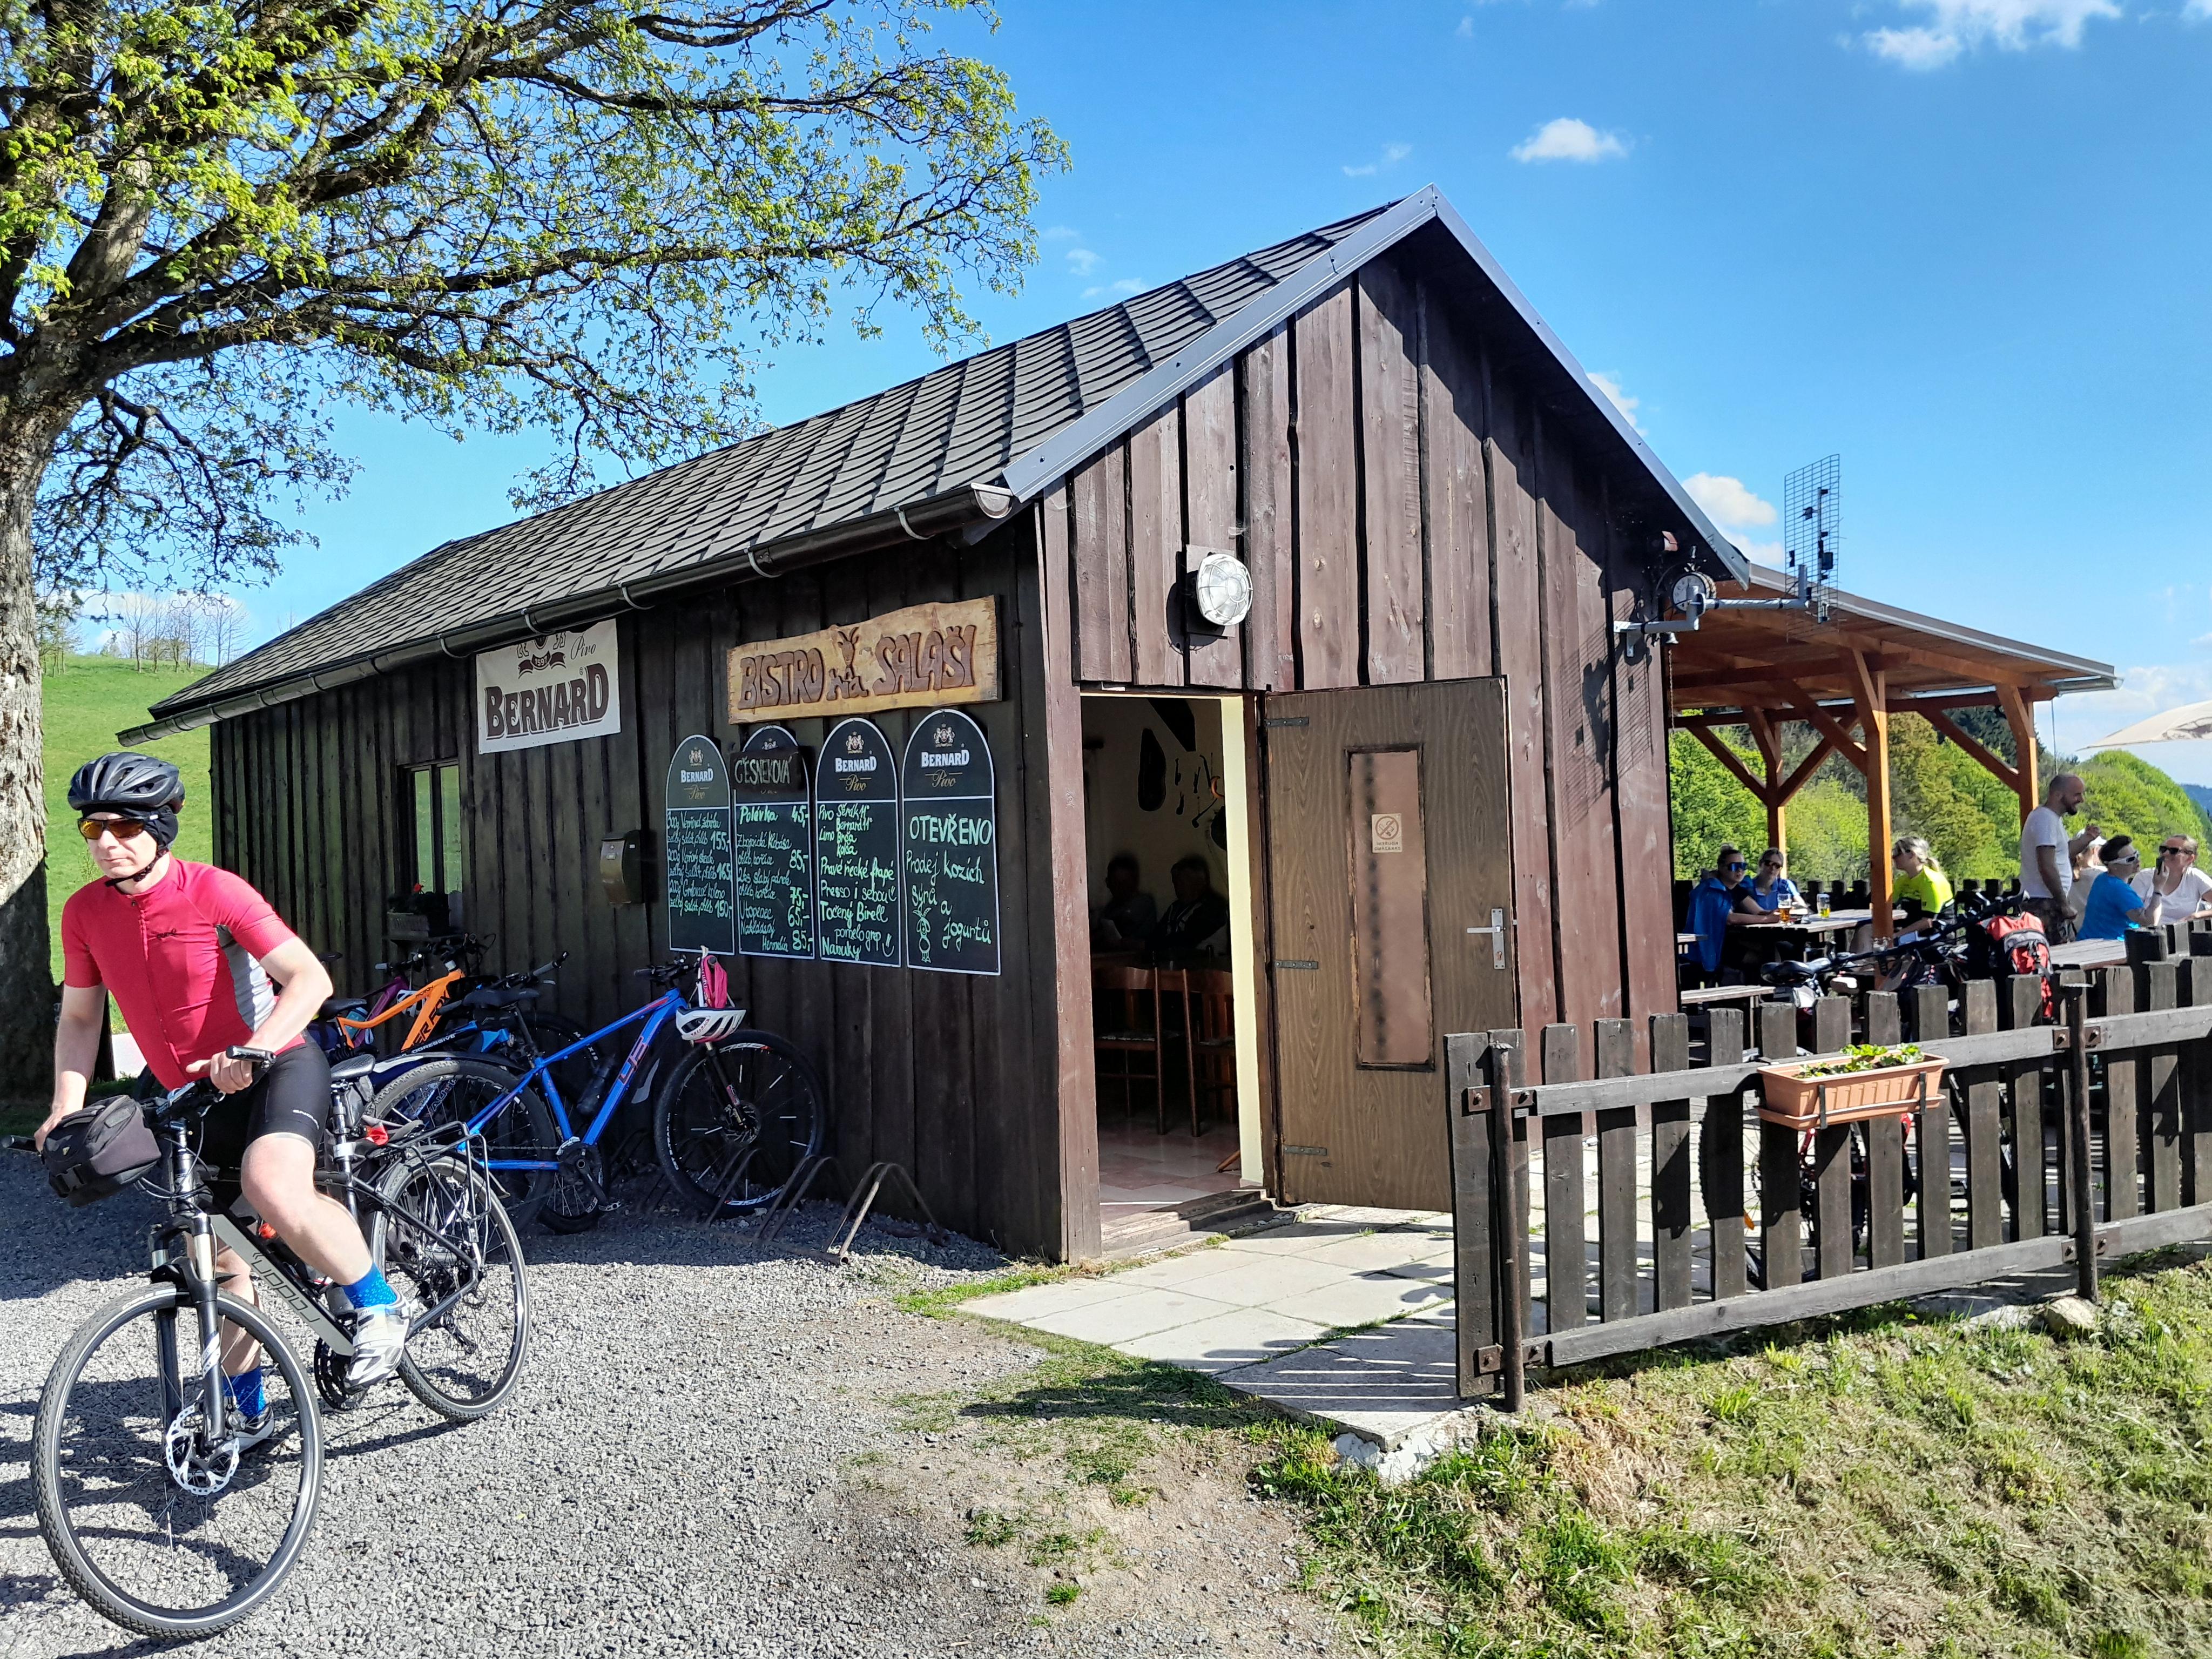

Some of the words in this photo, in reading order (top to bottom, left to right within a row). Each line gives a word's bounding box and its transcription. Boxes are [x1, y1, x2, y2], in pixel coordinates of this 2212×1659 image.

[570, 633, 596, 660] Pivo
[535, 655, 549, 666] 1597
[738, 648, 825, 710] BISTRO
[873, 624, 976, 696] SALAŠI
[484, 663, 609, 740] BERNARD
[835, 756, 877, 773] BERNARD
[921, 750, 970, 767] BERNARD
[680, 768, 713, 783] BERNARD
[846, 774, 866, 791] Pivo
[932, 769, 956, 787] Pivo
[739, 805, 779, 825] Polévka
[791, 805, 809, 828] 45,-
[819, 804, 834, 821] Pivo
[819, 826, 835, 841] Limo
[836, 817, 862, 832] Bernard
[909, 813, 993, 846] OTEVŘENO
[790, 849, 808, 873] 85,-
[820, 856, 842, 876] Pravé
[906, 850, 940, 886] Prodej
[944, 850, 985, 885] kozích
[790, 886, 808, 910] 75,-
[821, 880, 851, 898] Presso
[854, 881, 858, 899] i
[739, 900, 773, 921] Utopenec
[788, 906, 810, 927] 65,-
[820, 901, 854, 929] Točený
[857, 901, 888, 922] Birell
[941, 900, 953, 915] a
[792, 930, 813, 952] 85,-
[834, 924, 864, 944] pomelo
[942, 917, 992, 952] jogurtů
[822, 936, 861, 960] Nanuky
[251, 1259, 320, 1323] radon
